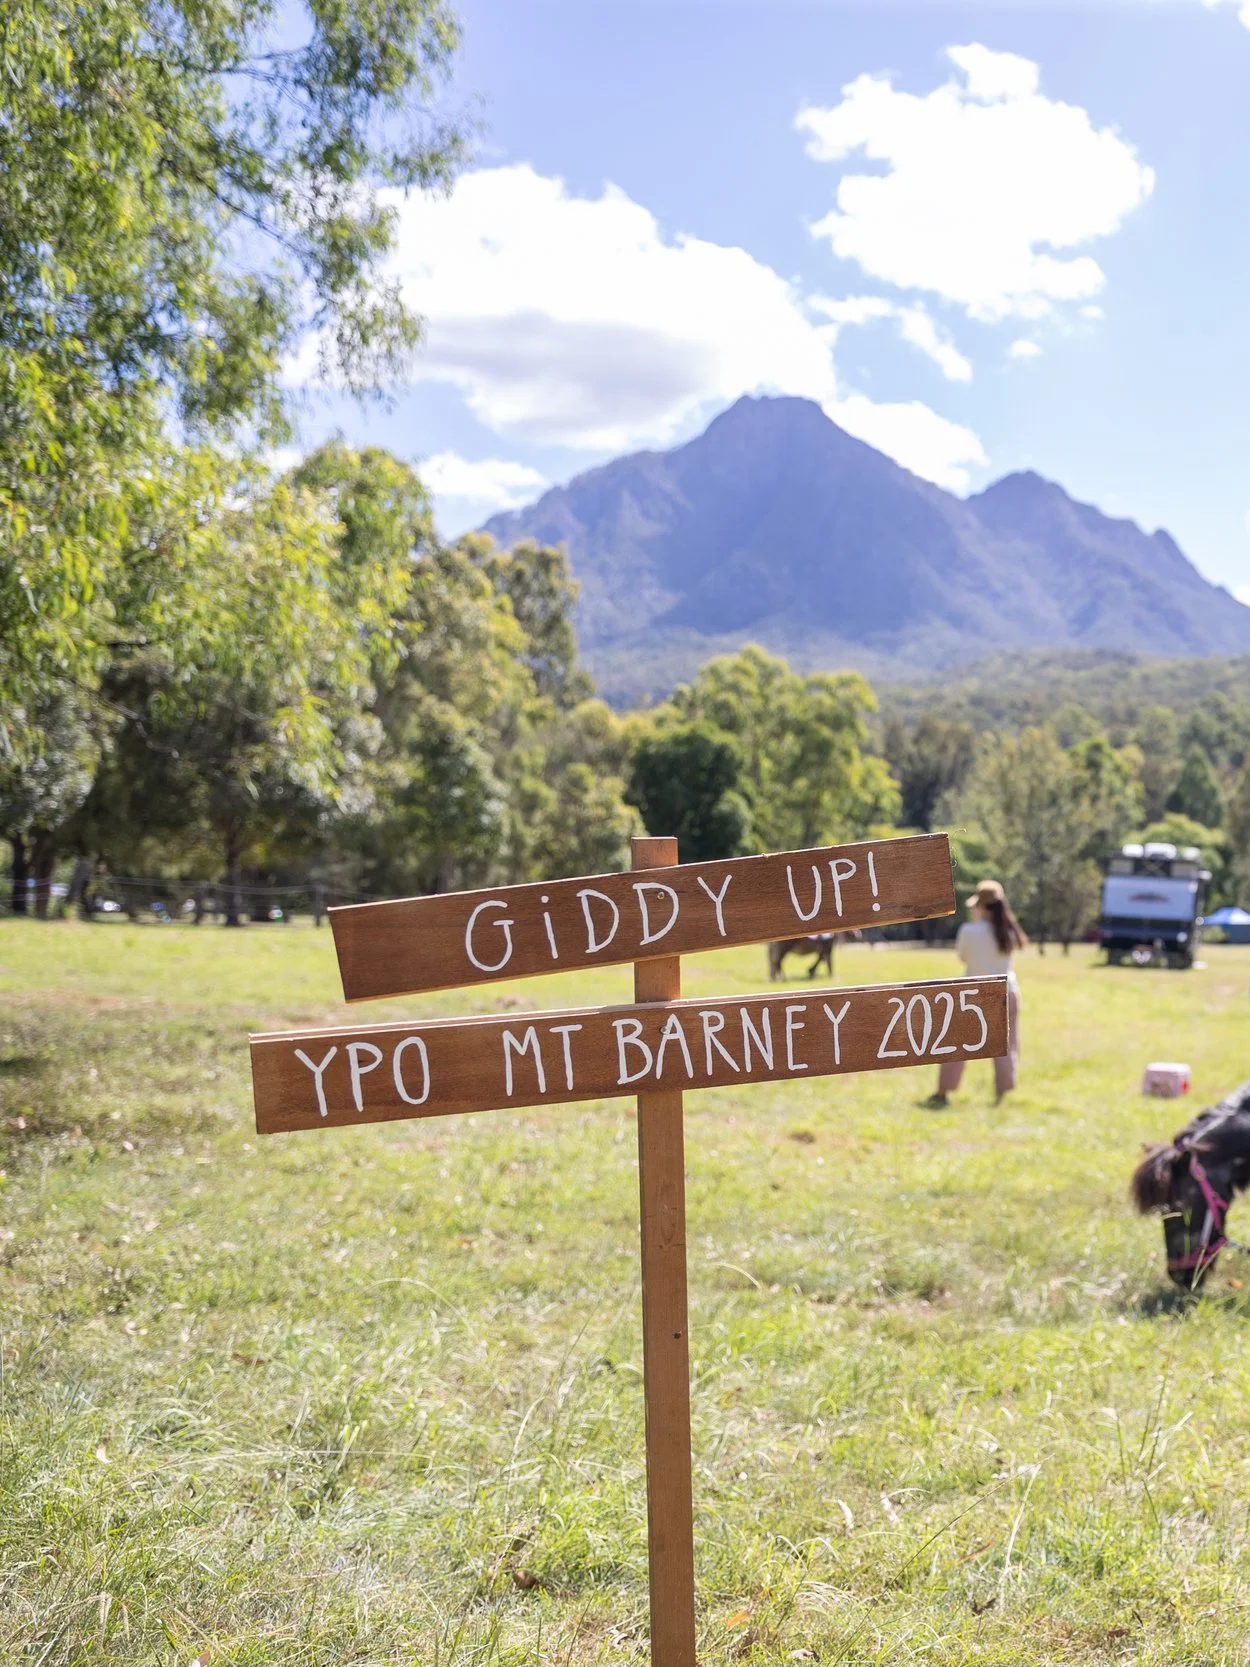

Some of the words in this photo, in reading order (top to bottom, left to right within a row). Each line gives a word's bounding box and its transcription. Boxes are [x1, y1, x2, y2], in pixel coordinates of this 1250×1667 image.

[786, 850, 882, 922] UP!
[293, 1036, 431, 1118] YPO
[501, 1023, 584, 1097] MT
[611, 1000, 852, 1085] BARNEY
[876, 988, 989, 1059] 2025
